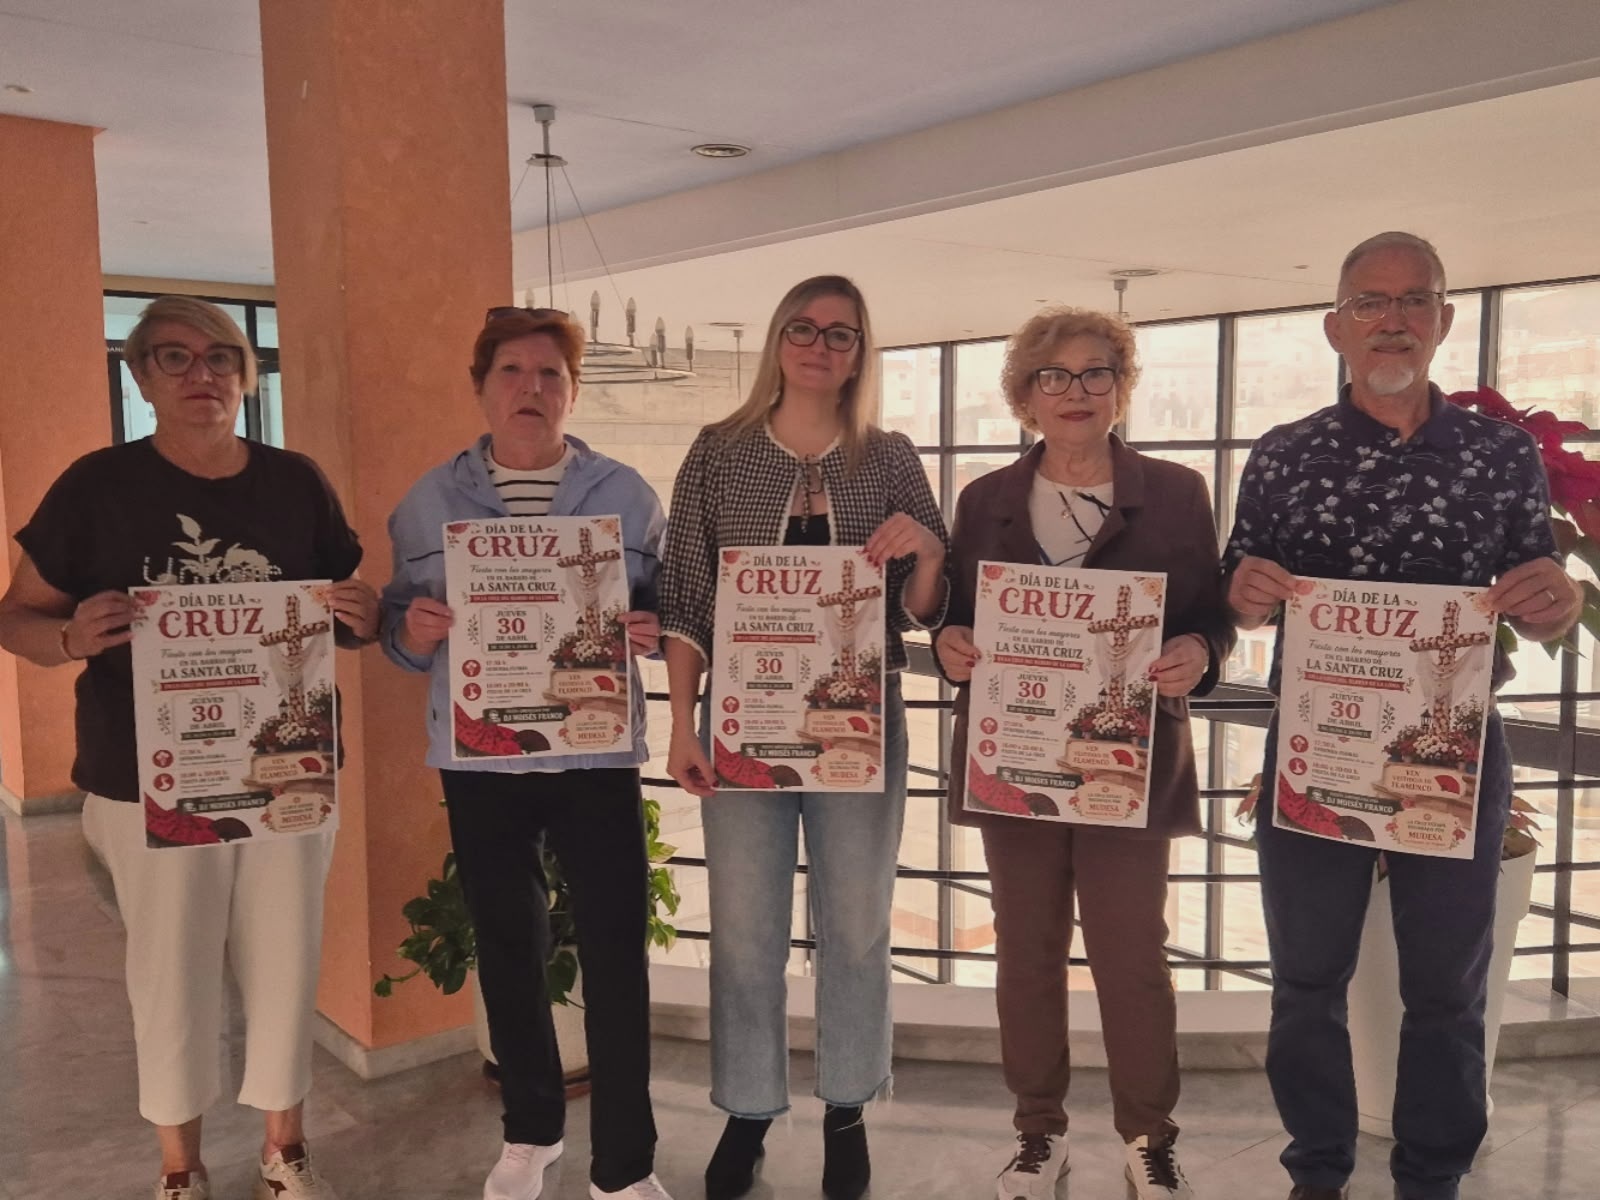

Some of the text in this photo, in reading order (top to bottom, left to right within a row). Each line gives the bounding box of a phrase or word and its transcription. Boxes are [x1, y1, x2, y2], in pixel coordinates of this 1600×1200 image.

[486, 522, 543, 534] DÍA DE LA
[466, 535, 562, 558] CRUZ
[754, 554, 807, 566] DÍA DE LA
[471, 582, 556, 592] LA SANTA CRUZ
[735, 569, 822, 595] CRUZ
[1020, 572, 1080, 590] DÍA DE LA
[179, 593, 245, 607] DÍA DE LA
[998, 587, 1096, 621] CRUZ
[1333, 588, 1400, 606] DÍA DE LA
[157, 607, 265, 640] CRUZ
[498, 618, 525, 634] 30
[735, 621, 814, 632] LA SANTA CRUZ
[1309, 603, 1419, 638] CRUZ
[998, 623, 1019, 633] Fiesta
[1048, 630, 1080, 641] mayores
[996, 642, 1082, 659] LA SANTA CRUZ
[1309, 639, 1332, 651] Fiesta
[1364, 648, 1401, 660] mayores
[161, 664, 257, 680] LA SANTA CRUZ
[757, 658, 782, 673] 30
[1307, 659, 1403, 678] LA SANTA CRUZ
[1017, 674, 1049, 682] JUEVES
[1018, 681, 1046, 699] 30
[1329, 693, 1364, 702] JUEVES
[189, 696, 224, 705] JUEVES
[192, 704, 223, 723] 30
[1331, 700, 1361, 720] 30
[1391, 781, 1432, 792] FLAMENCO
[1364, 803, 1394, 814] FRANCO
[1408, 830, 1443, 843] MUDESA
